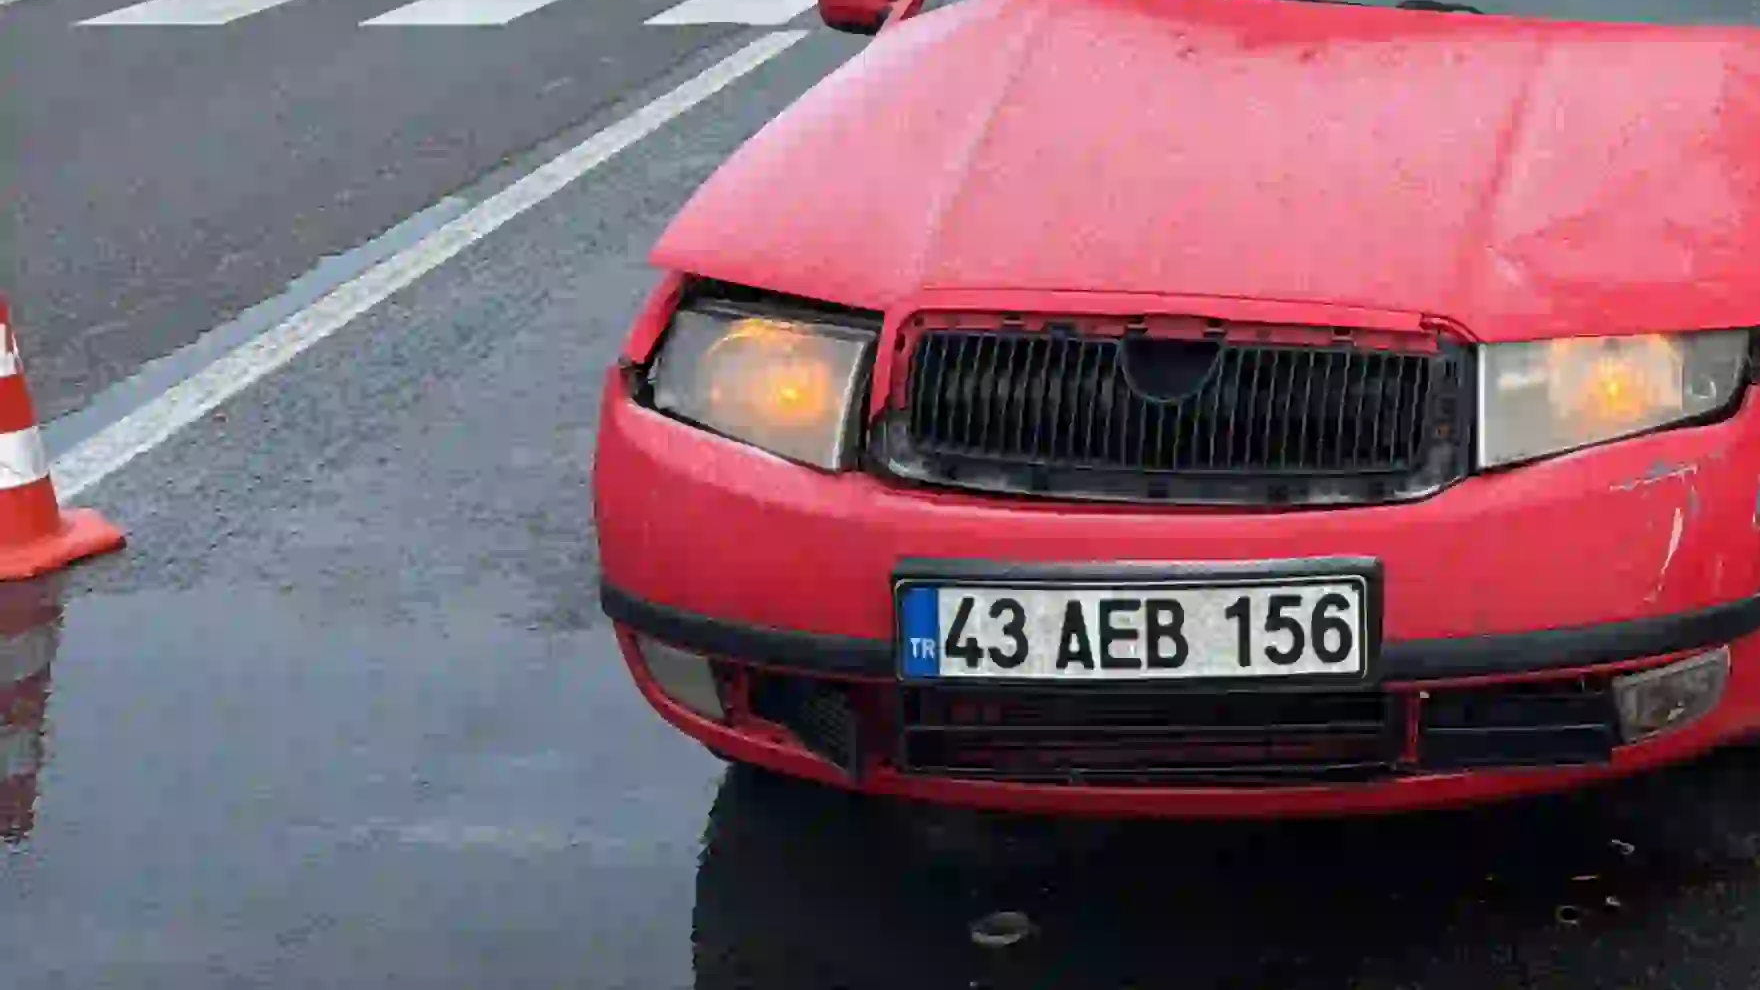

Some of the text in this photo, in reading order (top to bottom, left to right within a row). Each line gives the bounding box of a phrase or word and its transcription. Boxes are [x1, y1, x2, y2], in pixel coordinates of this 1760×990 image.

[910, 593, 1353, 670] TR 43 AEB 156
